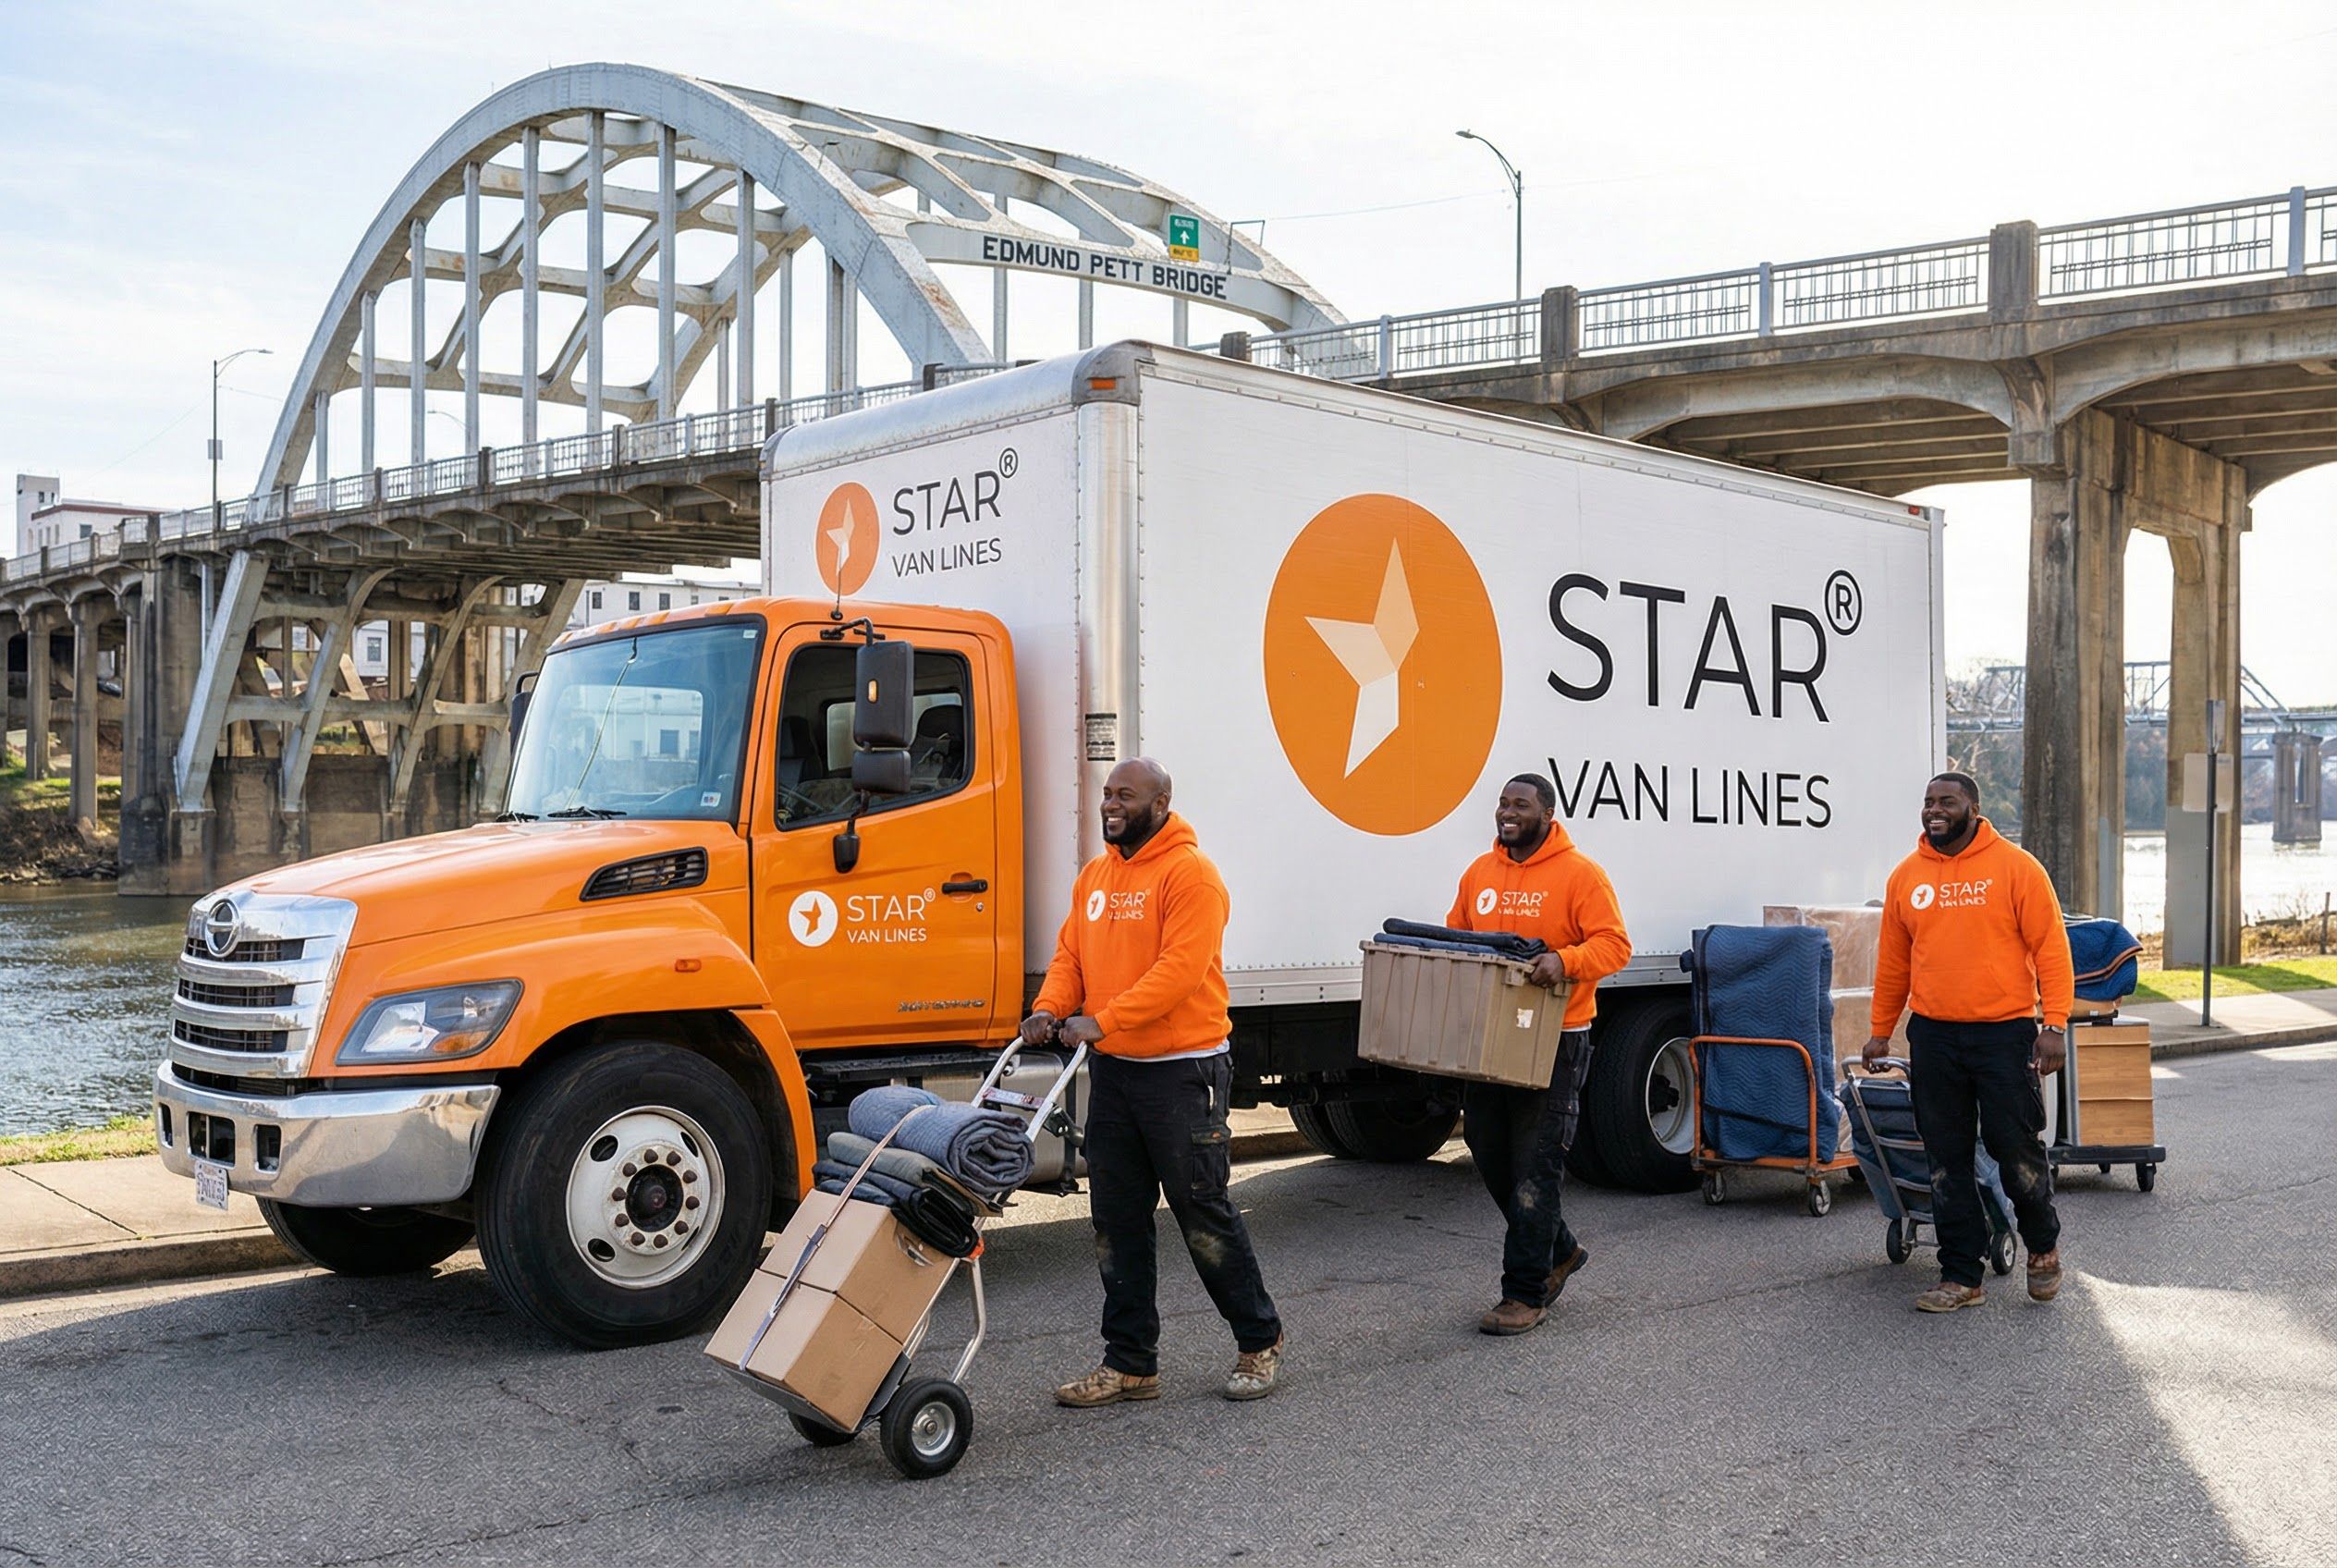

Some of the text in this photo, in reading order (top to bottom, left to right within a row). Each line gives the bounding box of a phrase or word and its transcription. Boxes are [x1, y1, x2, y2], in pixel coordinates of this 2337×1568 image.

[983, 236, 1227, 300] EDMUND PETT BRIDGE
[892, 537, 1002, 578] VAN LINES
[1548, 757, 1831, 828] VAN LINES
[847, 927, 926, 943] VAN LINES
